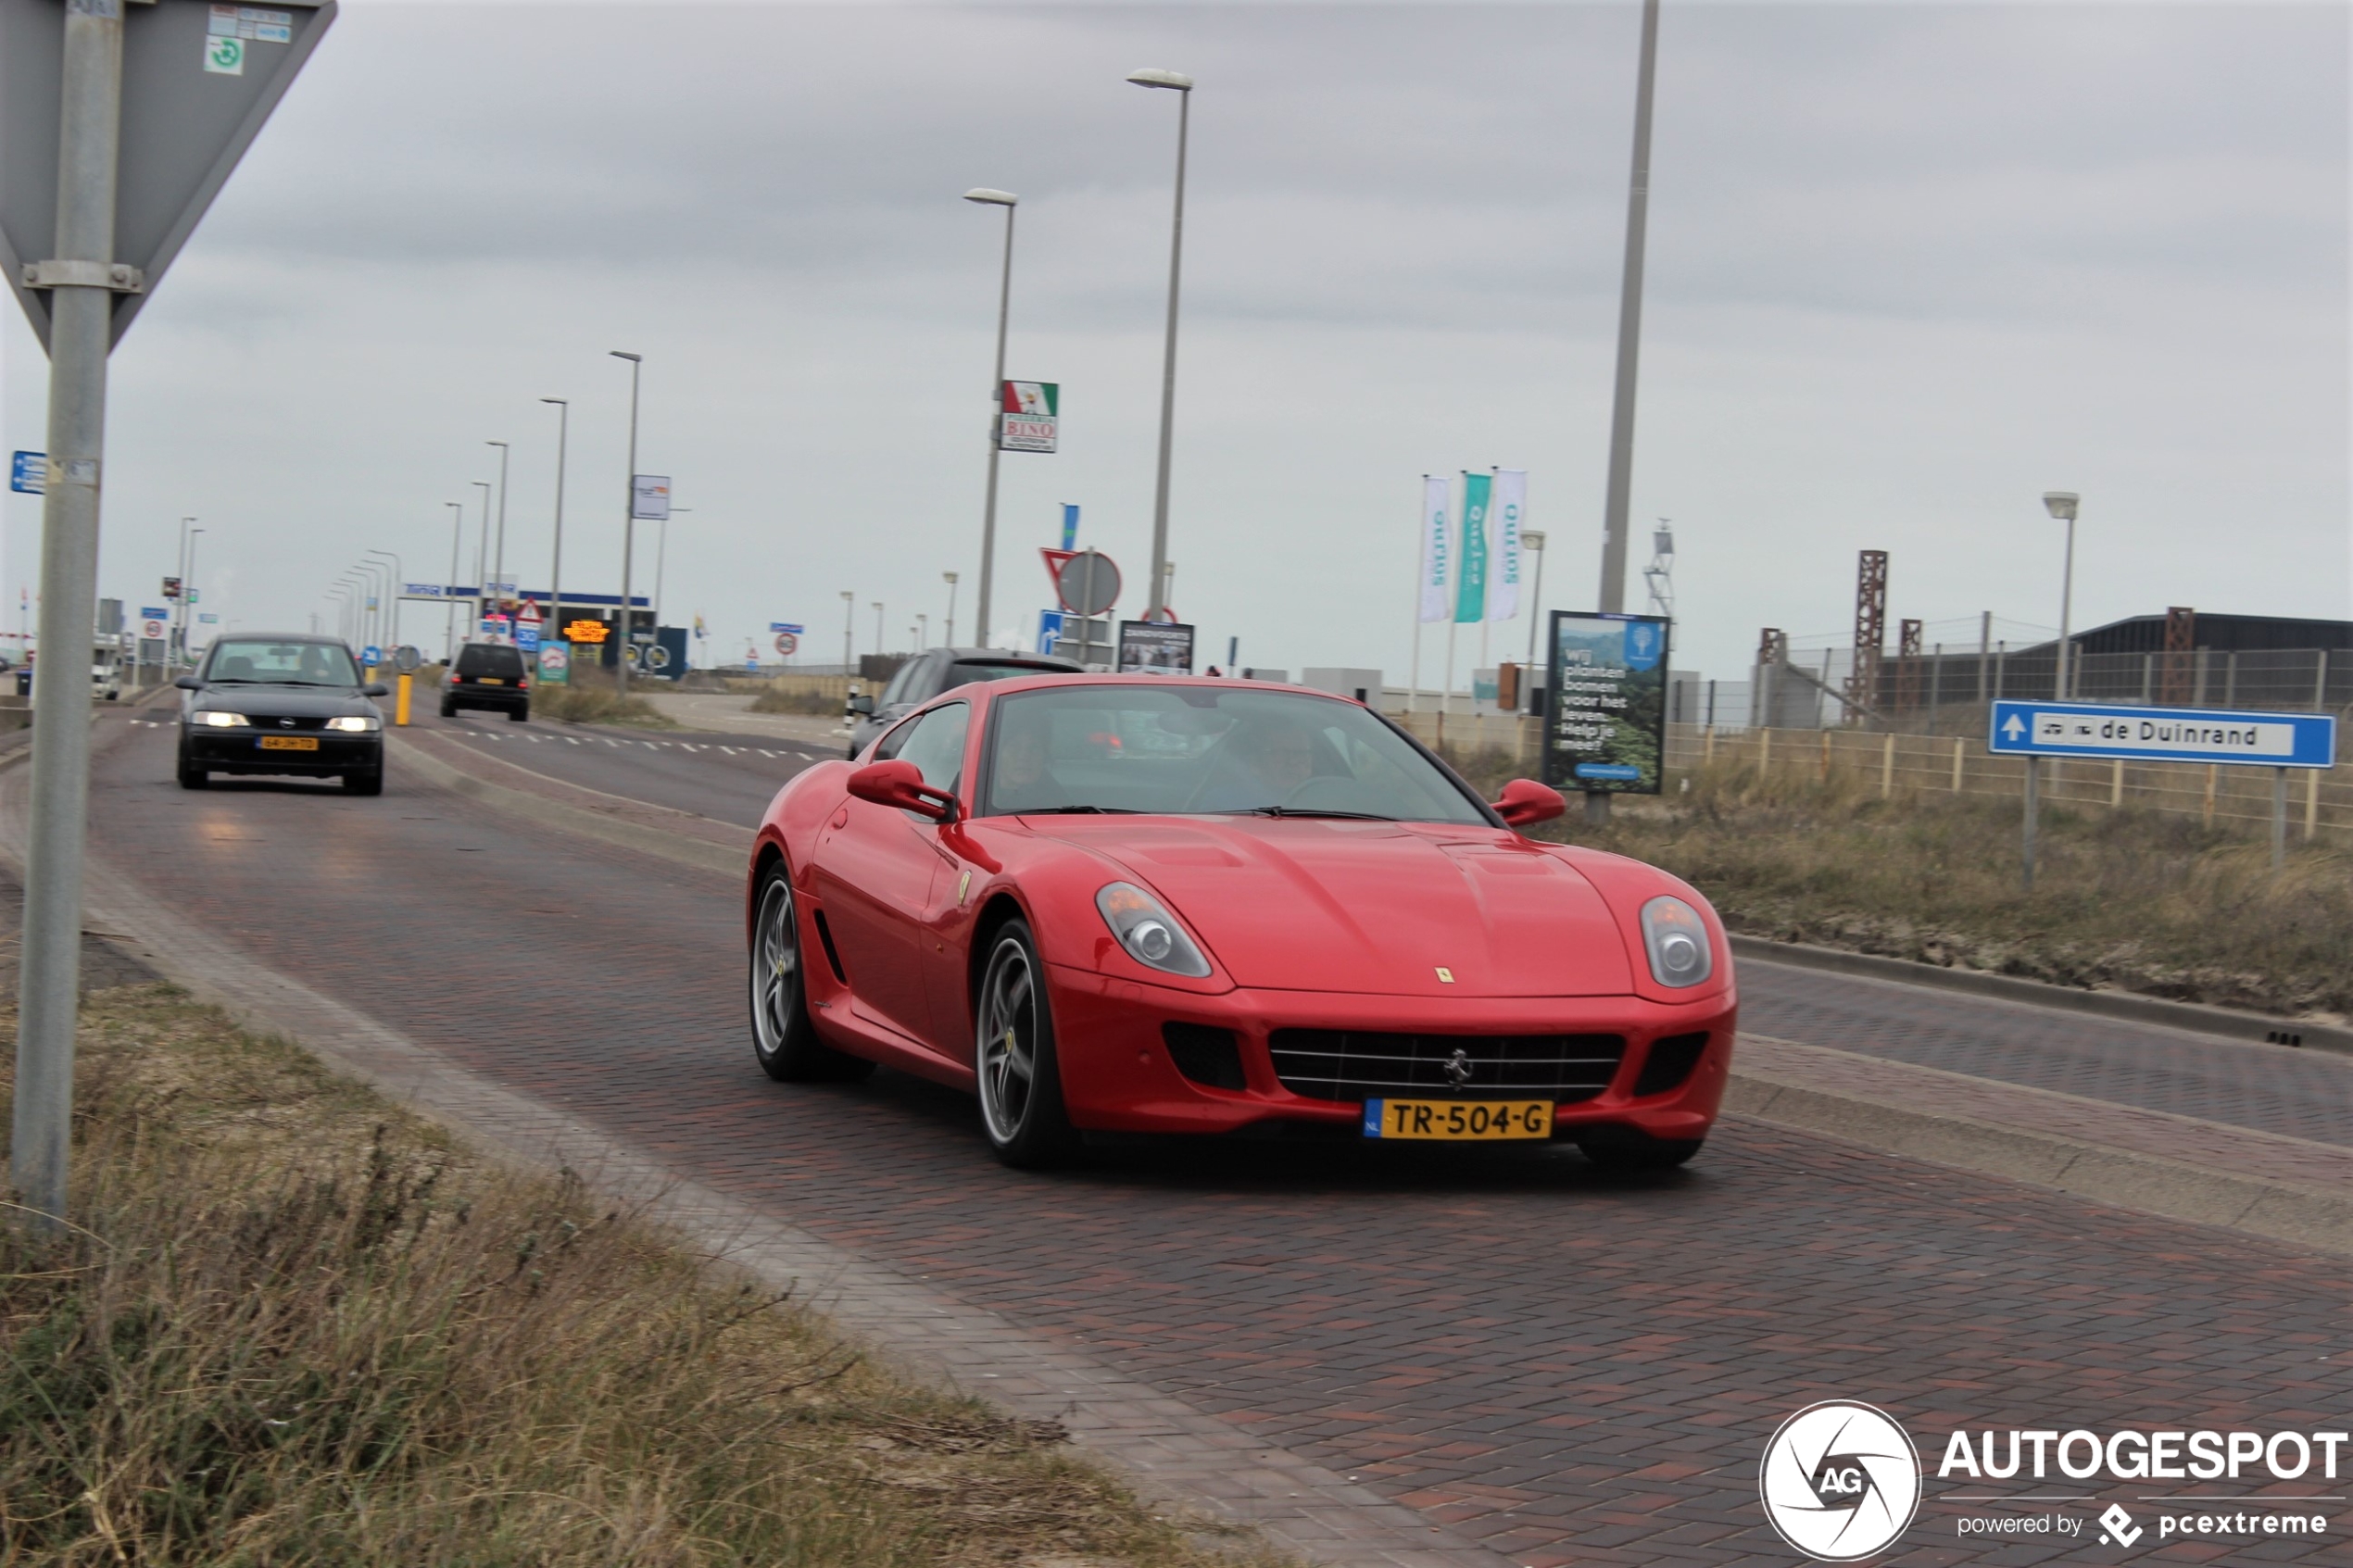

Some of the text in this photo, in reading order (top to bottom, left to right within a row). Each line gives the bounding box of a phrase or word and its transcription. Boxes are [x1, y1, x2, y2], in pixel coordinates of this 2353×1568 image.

[1007, 421, 1054, 437] BINO
[1564, 664, 1626, 681] planten
[1563, 678, 1618, 693] bomen
[1562, 696, 1628, 709] voor het
[1560, 722, 1616, 740] Help je
[2102, 721, 2258, 746] de Duinrand
[1560, 739, 1603, 751] mee?
[1393, 1105, 1543, 1134] TR-504-G
